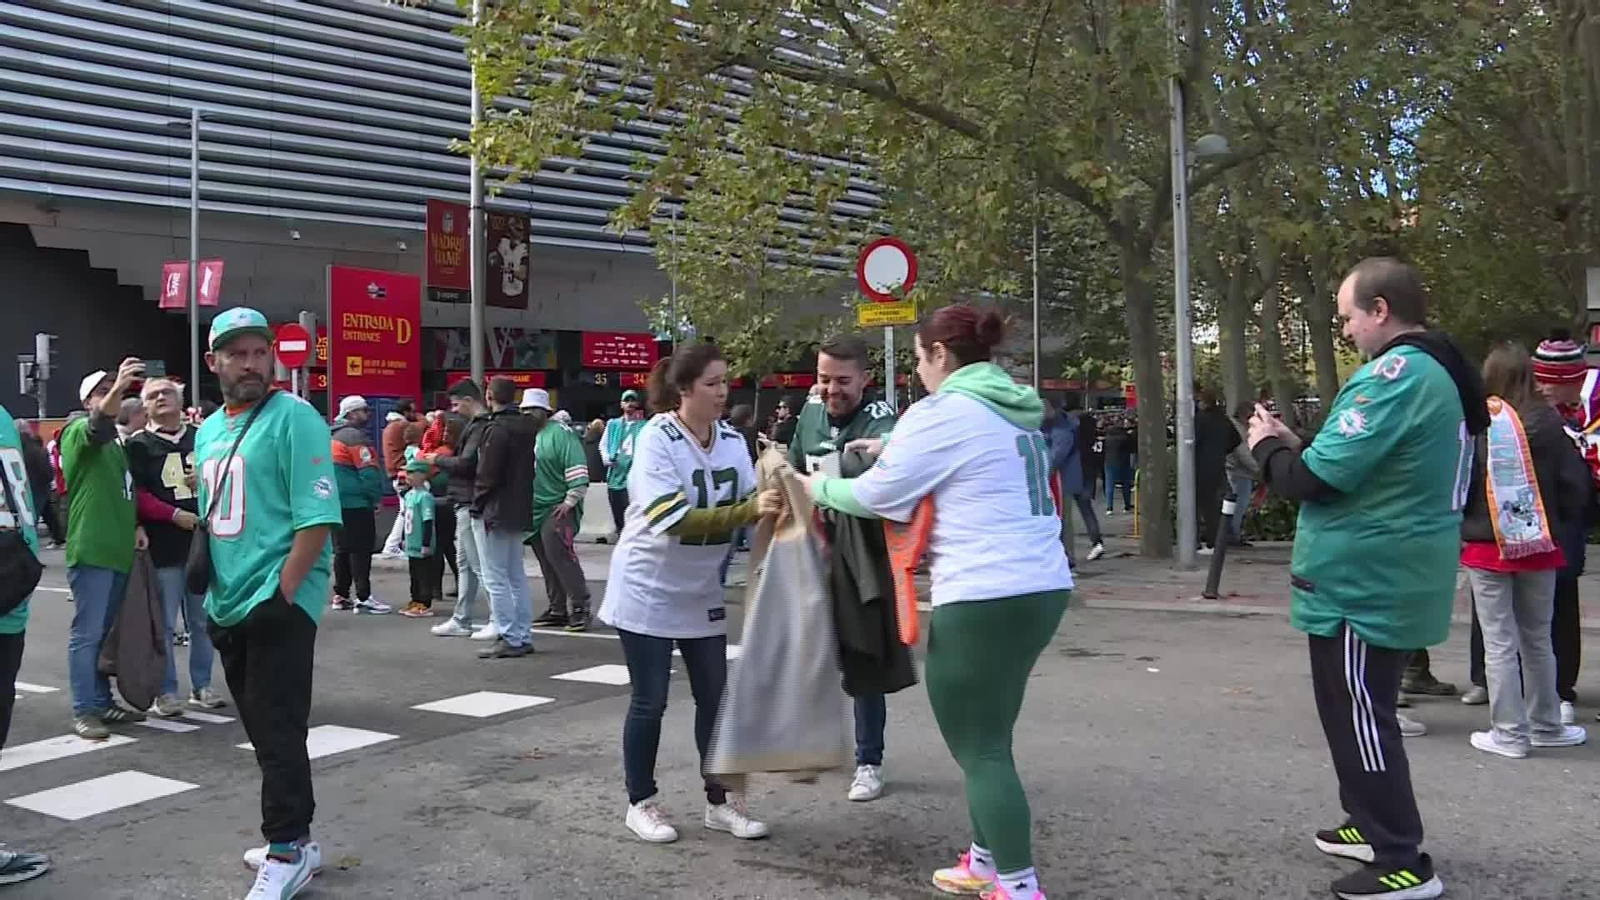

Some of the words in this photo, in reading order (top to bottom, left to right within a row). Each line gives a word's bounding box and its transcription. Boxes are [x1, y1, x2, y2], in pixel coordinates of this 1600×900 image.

[342, 312, 394, 331] ENTRADA
[396, 318, 412, 344] D
[342, 329, 381, 342] ENTRANCE
